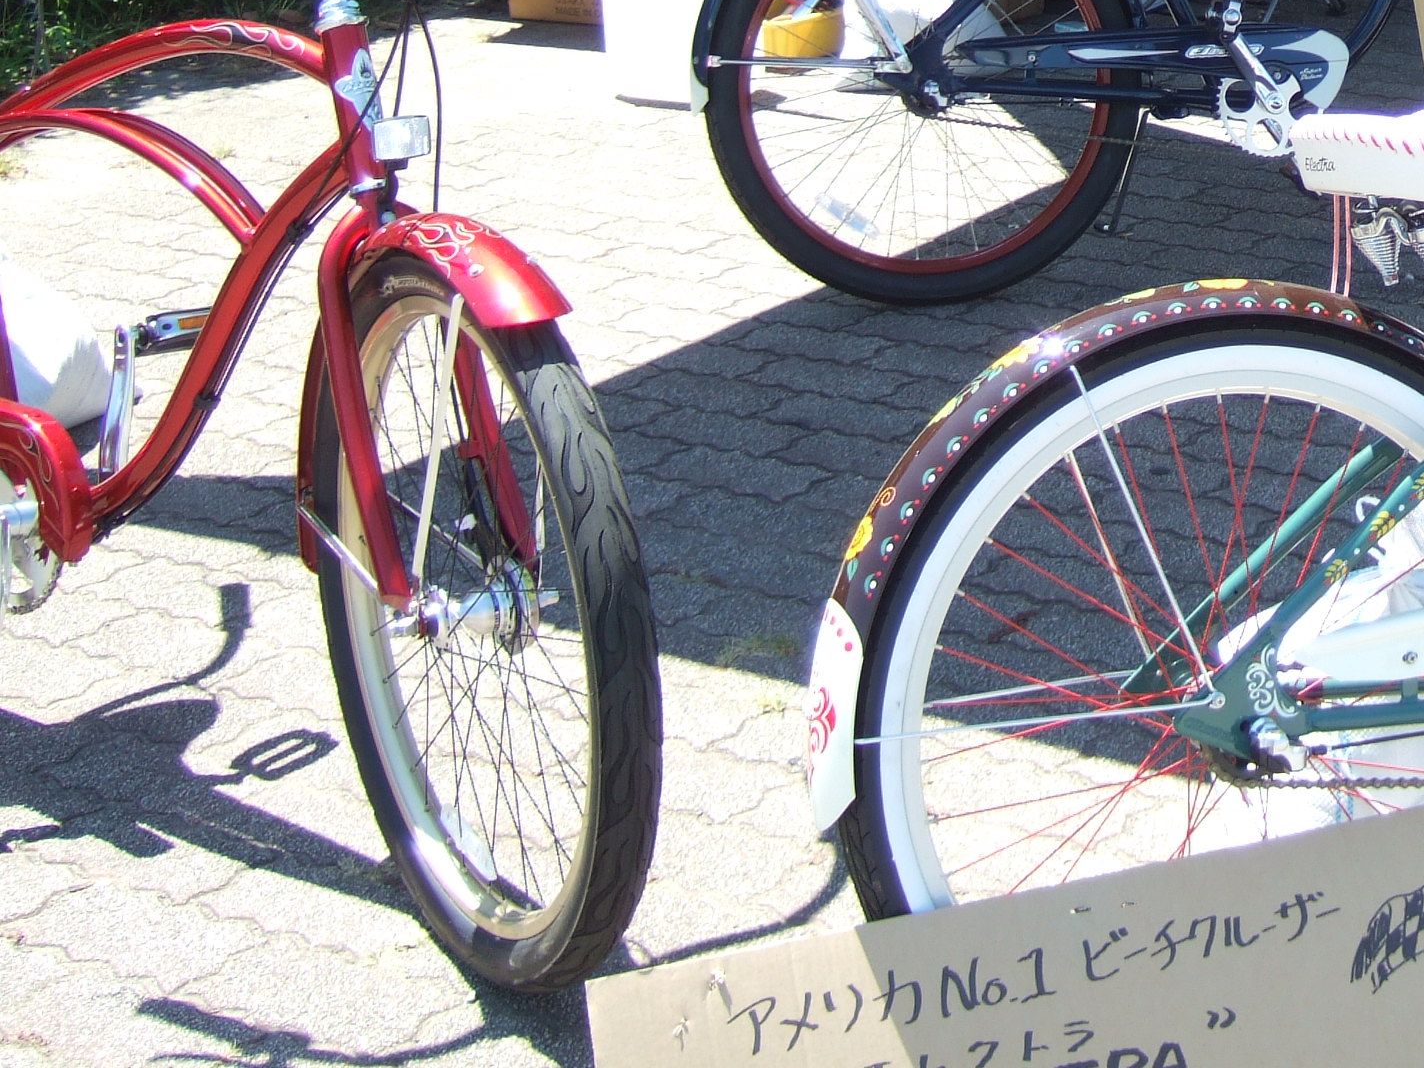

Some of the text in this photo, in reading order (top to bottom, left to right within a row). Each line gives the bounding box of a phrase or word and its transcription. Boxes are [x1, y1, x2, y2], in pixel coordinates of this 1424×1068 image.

[1304, 156, 1336, 172] Electra
[726, 891, 1341, 1056] アメリカ No.1 ビーチクルーザー
